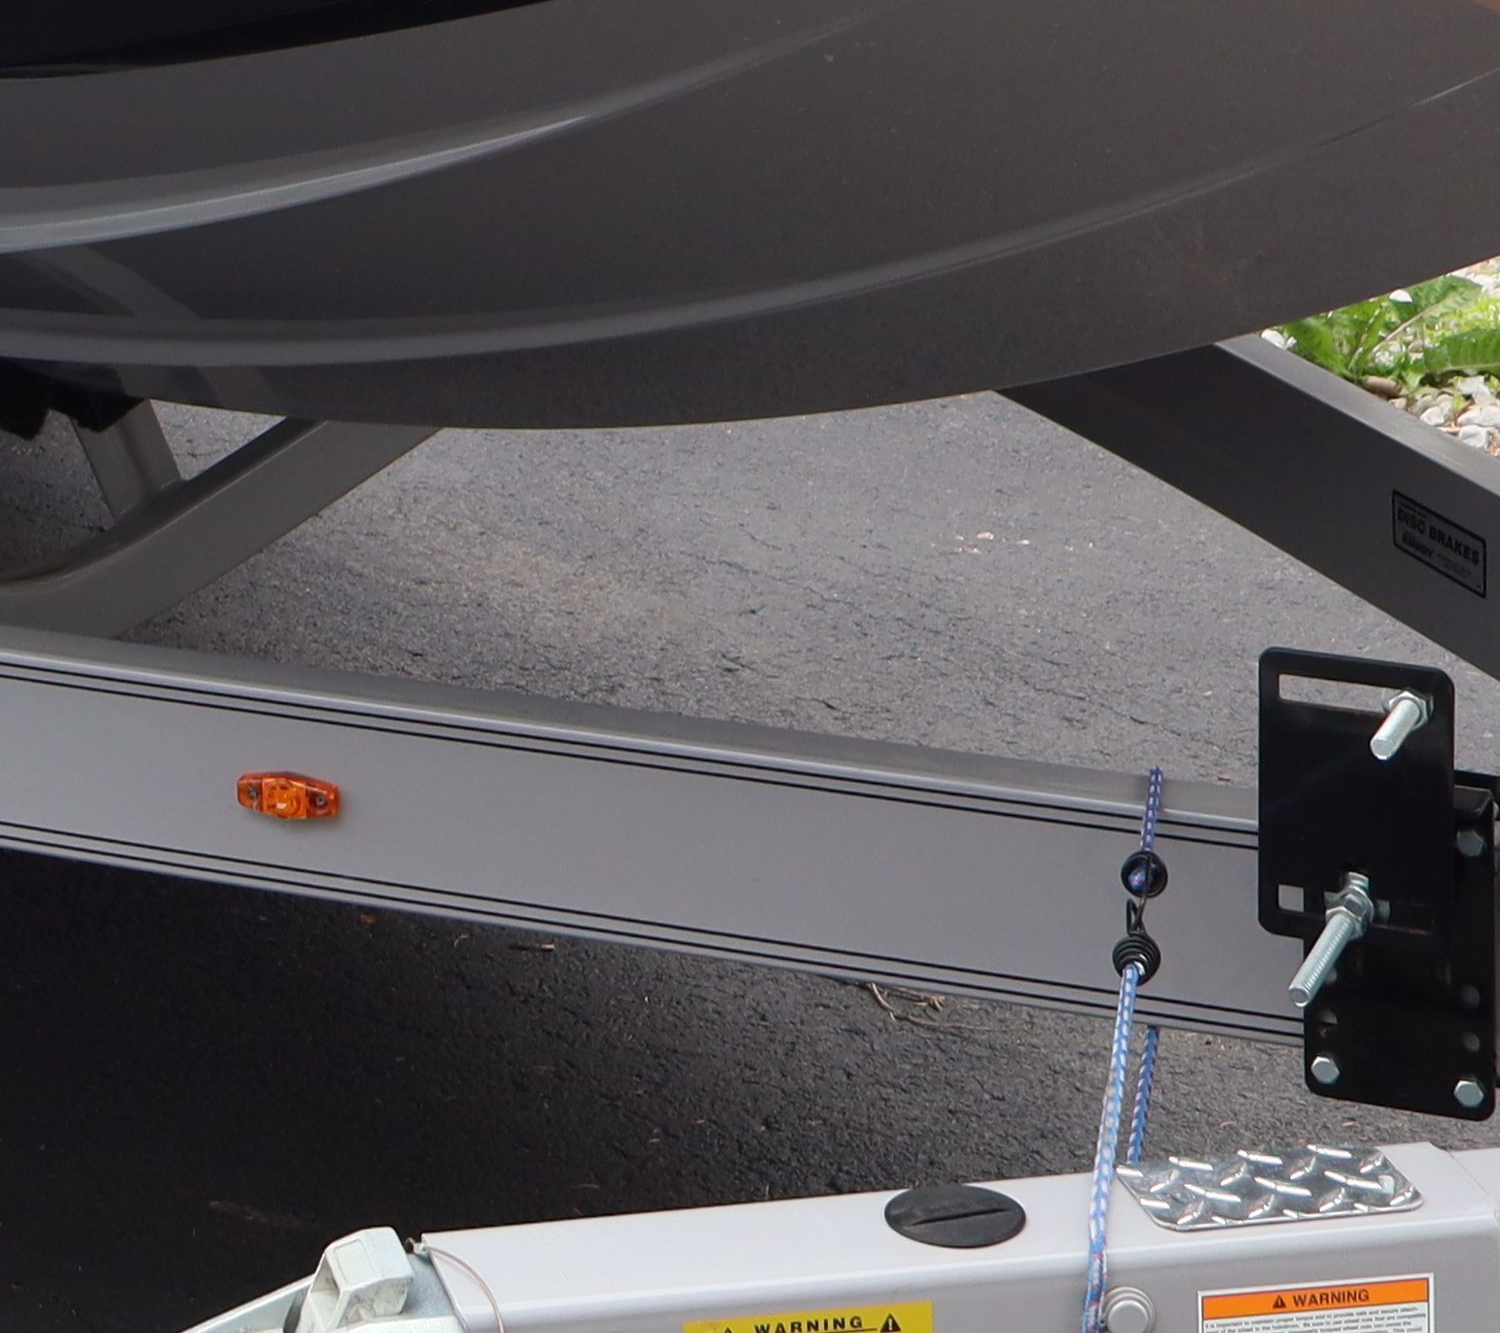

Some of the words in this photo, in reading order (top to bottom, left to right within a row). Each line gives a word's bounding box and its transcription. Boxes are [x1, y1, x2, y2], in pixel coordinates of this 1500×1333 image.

[1428, 525, 1480, 566] BRAKES
[1292, 1289, 1370, 1307] WARNING
[754, 1316, 863, 1333] WARNING
